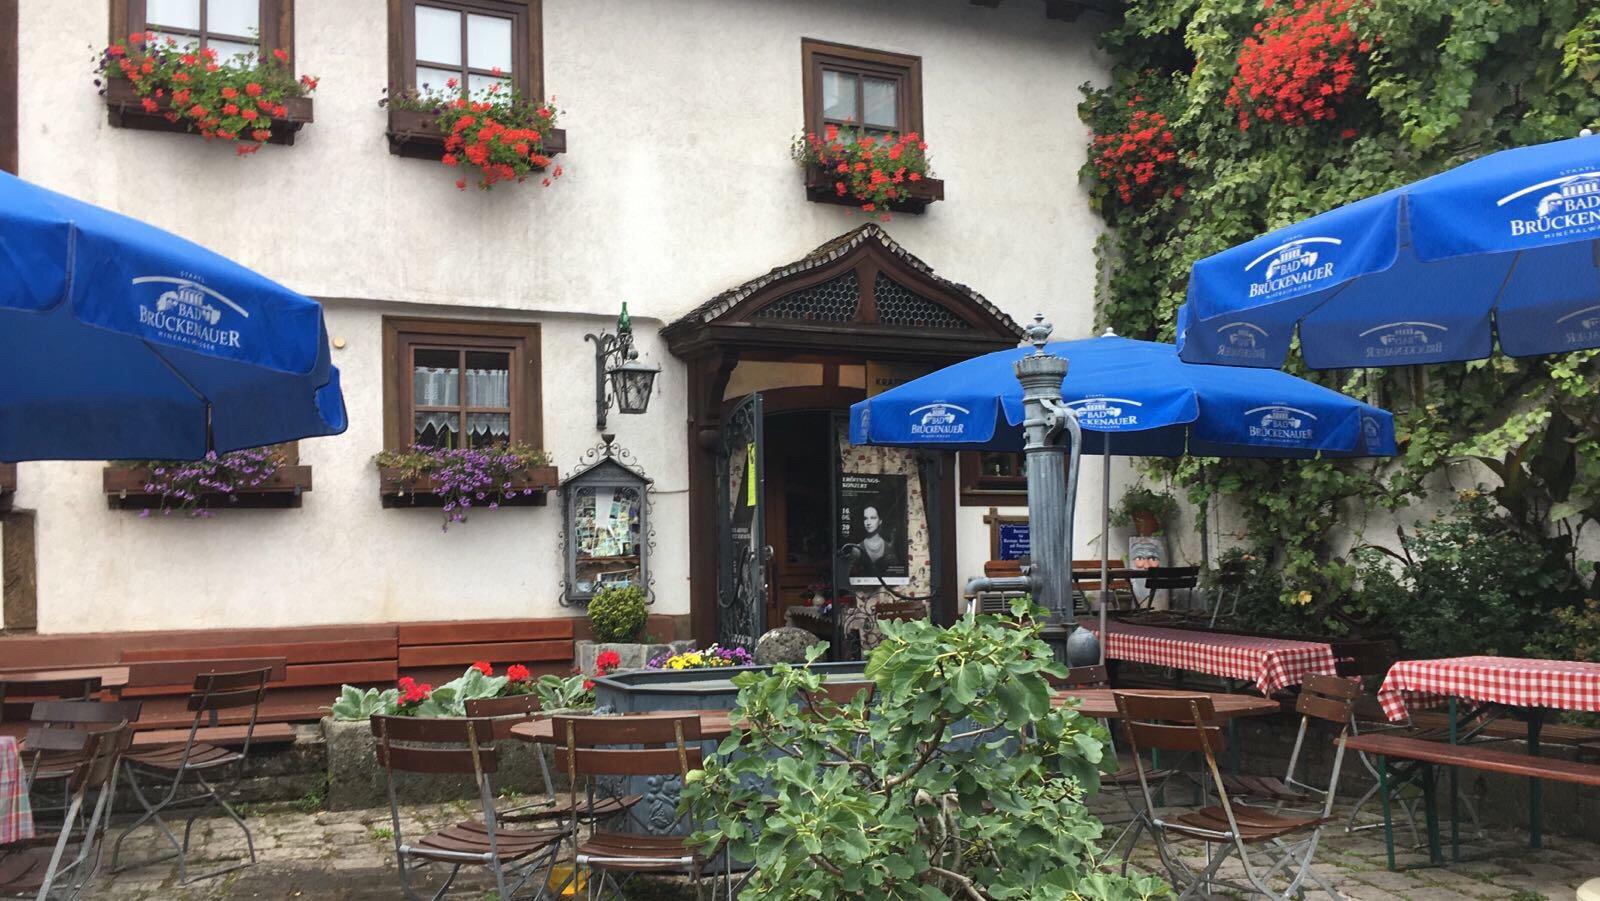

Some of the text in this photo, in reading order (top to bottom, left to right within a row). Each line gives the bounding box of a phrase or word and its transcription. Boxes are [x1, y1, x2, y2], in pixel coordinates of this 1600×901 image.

[1564, 195, 1600, 212] BAD
[1280, 260, 1301, 276] BAD
[1249, 262, 1334, 298] BRÜCKENAUER
[178, 302, 202, 321] BAD
[139, 304, 241, 348] BRÜCKENAUER
[1087, 410, 1107, 419] BAD
[911, 423, 964, 434] BRÜCKENAUER
[1249, 425, 1313, 440] BRÜCKENAUER
